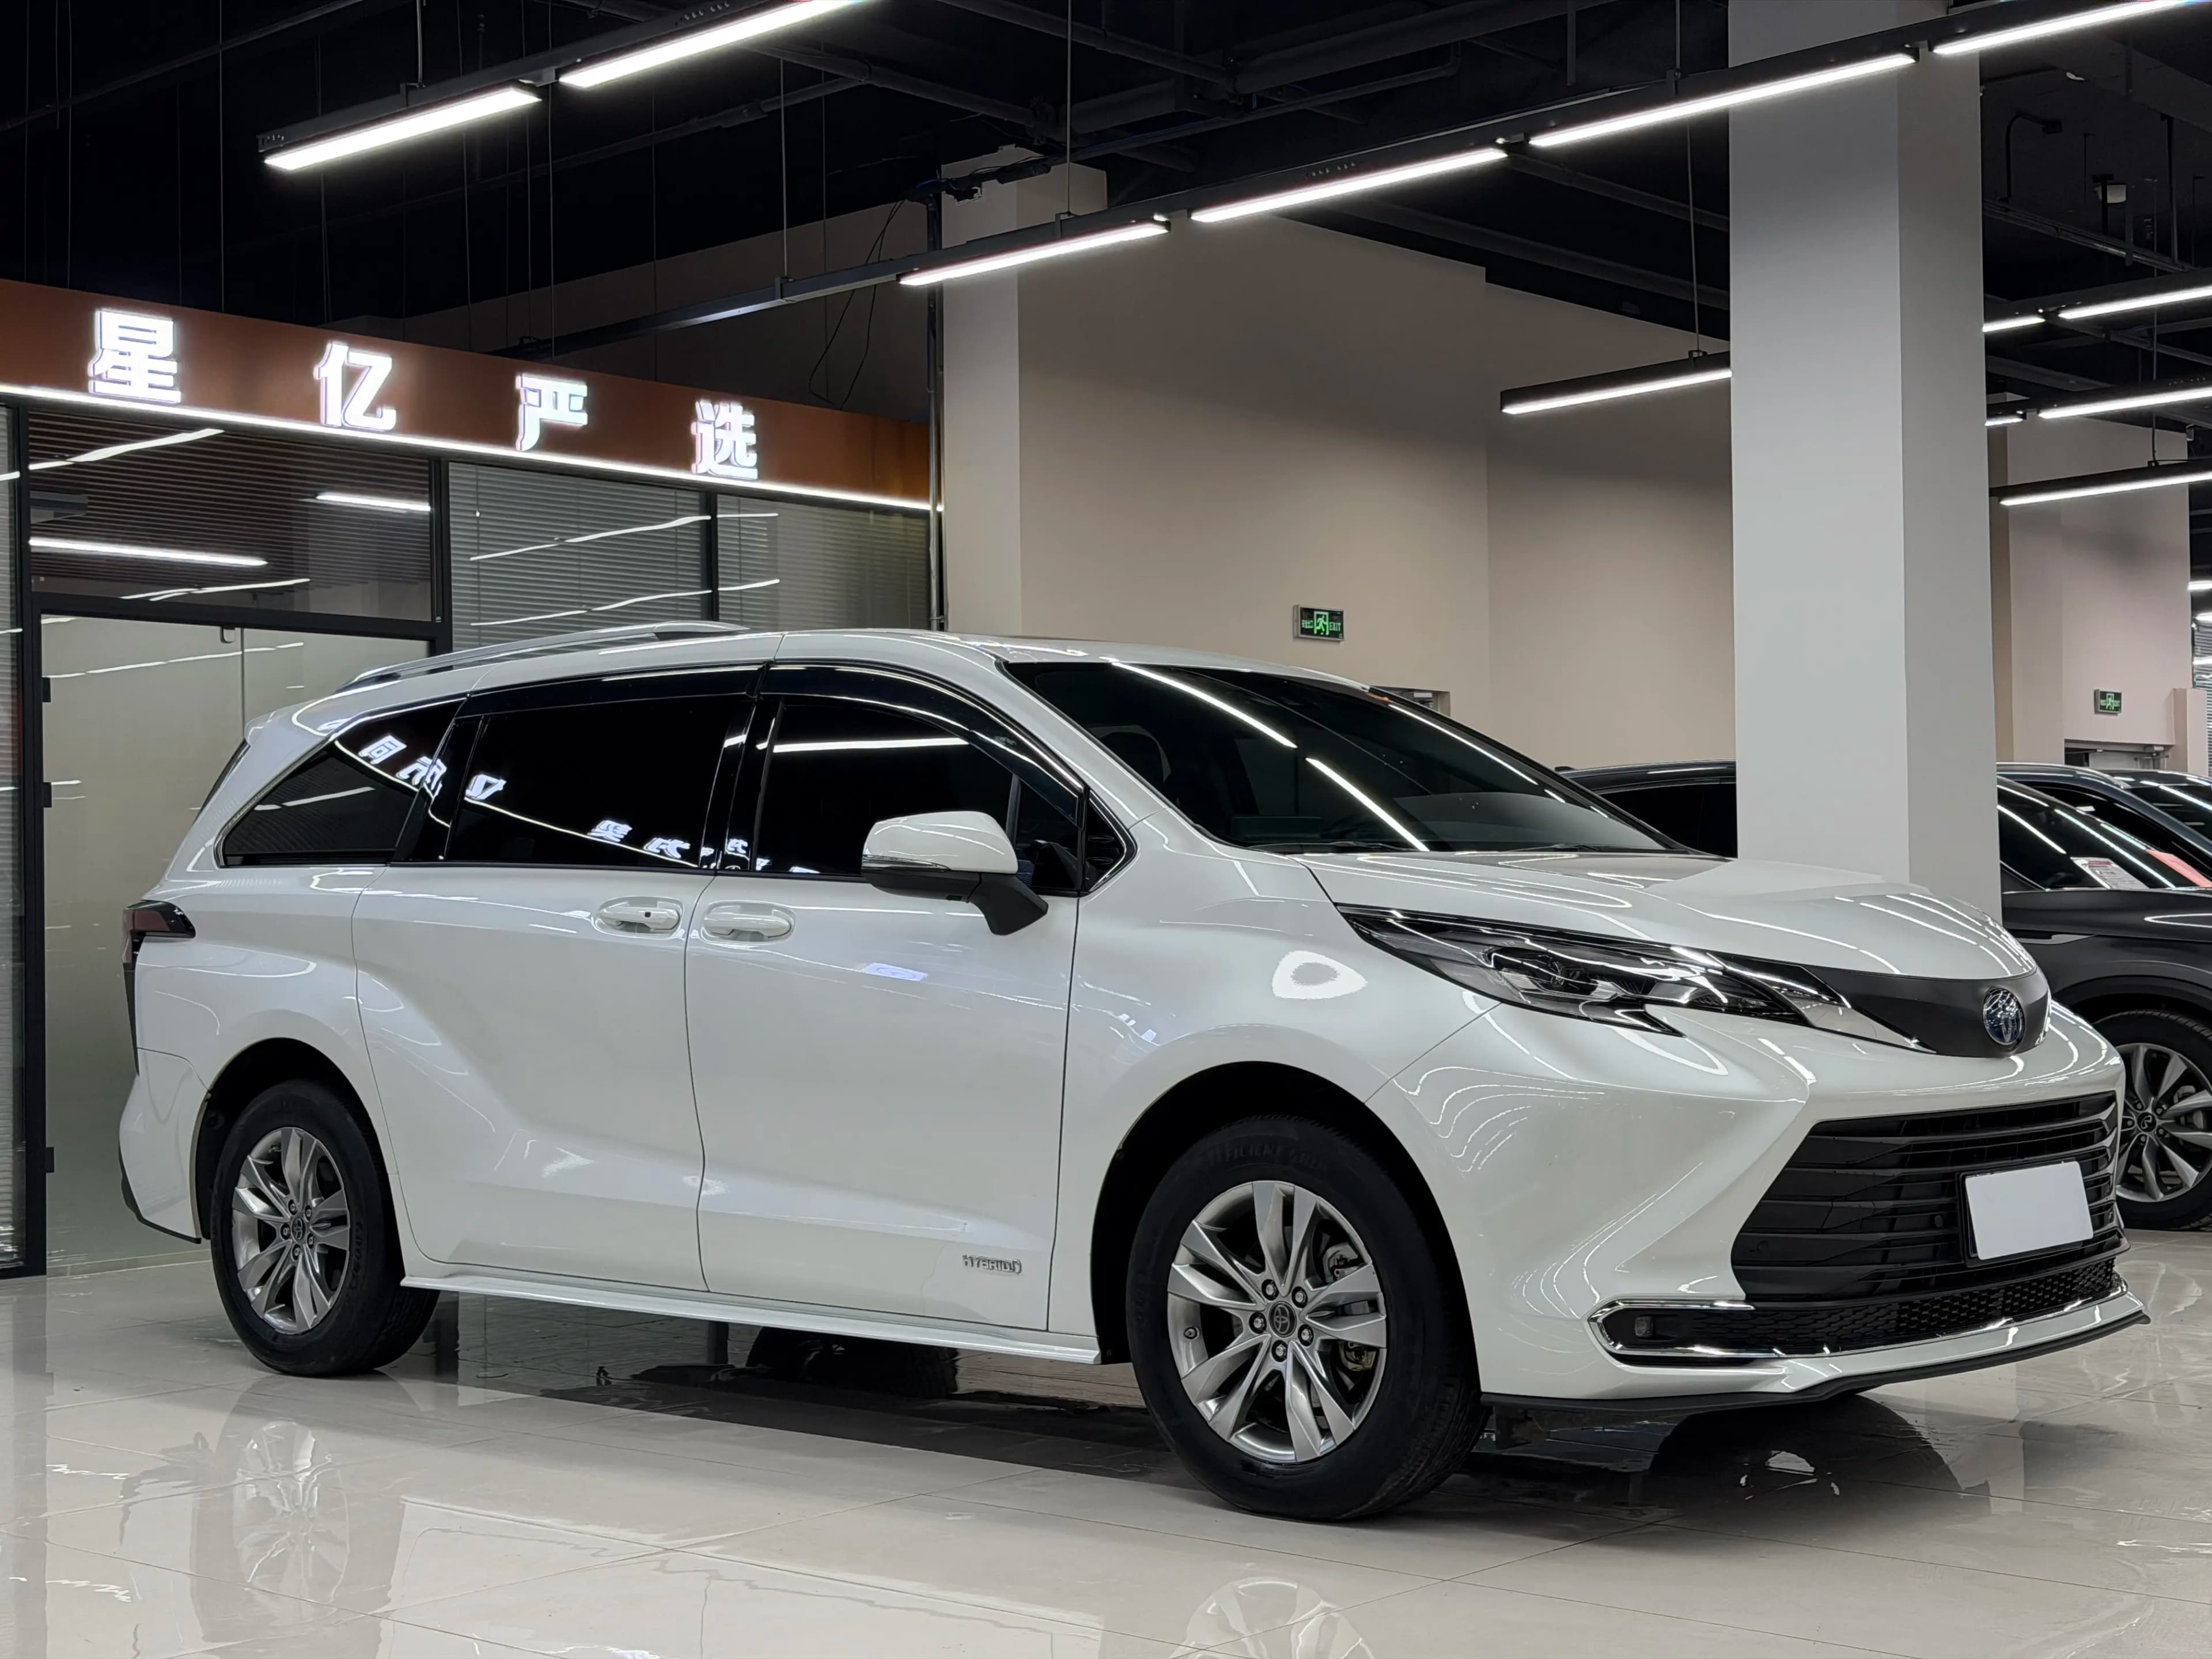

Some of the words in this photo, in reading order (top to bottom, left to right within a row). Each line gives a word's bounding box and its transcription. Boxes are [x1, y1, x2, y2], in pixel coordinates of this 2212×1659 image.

[88, 309, 758, 480] 星亿严选
[1330, 622, 1342, 631] EXIT
